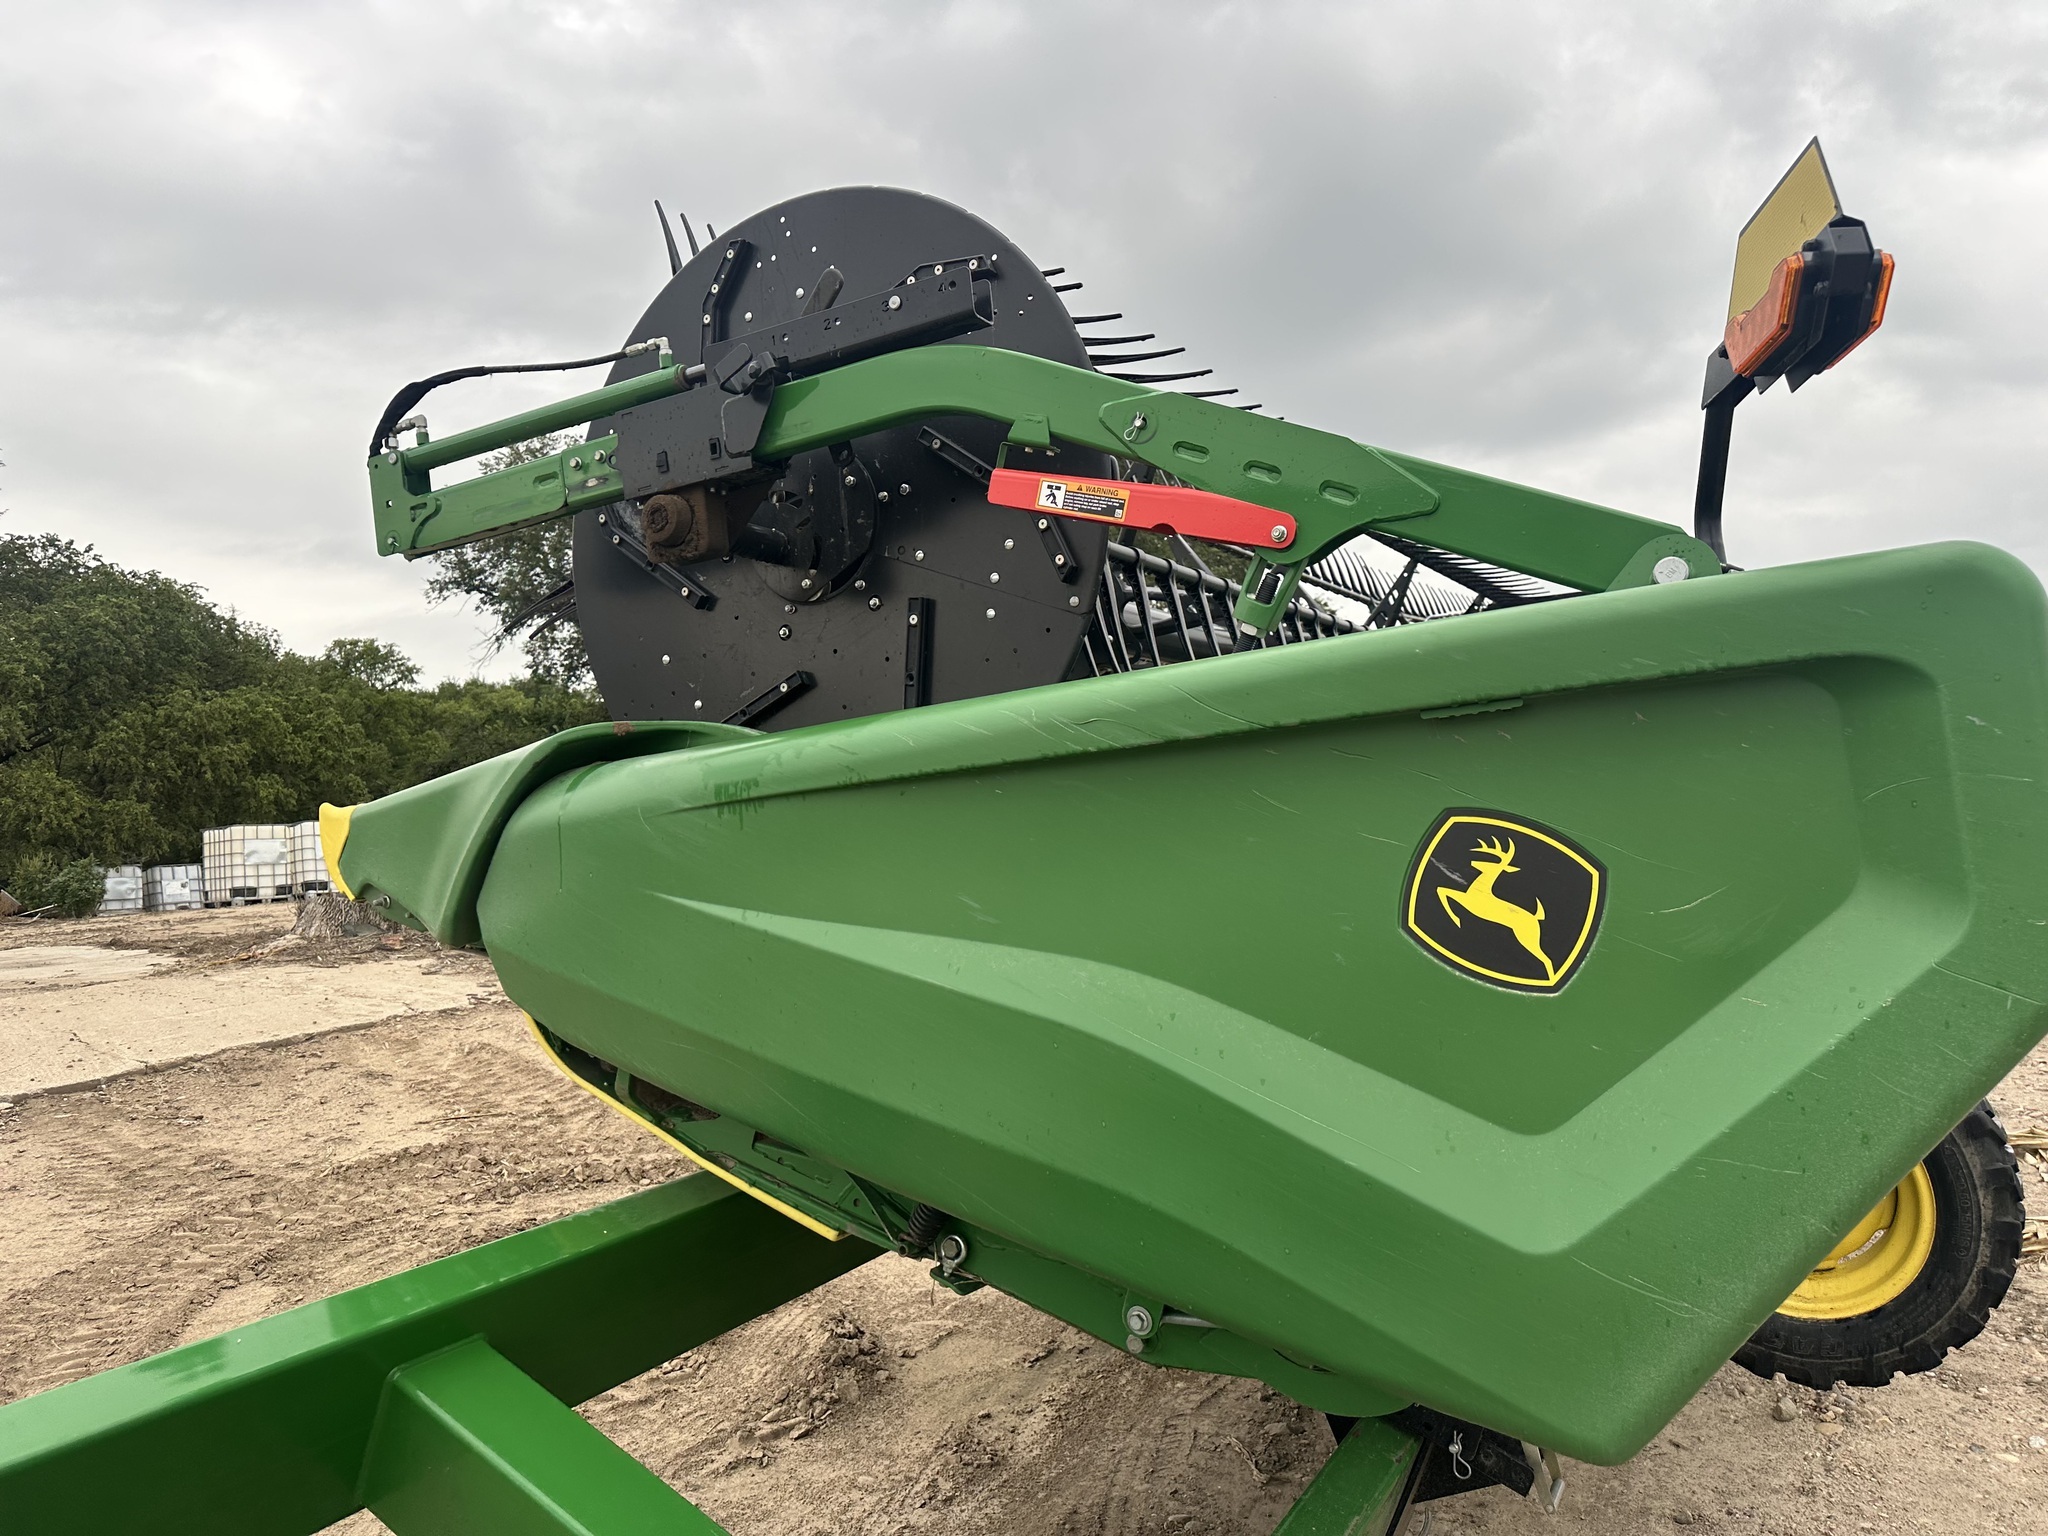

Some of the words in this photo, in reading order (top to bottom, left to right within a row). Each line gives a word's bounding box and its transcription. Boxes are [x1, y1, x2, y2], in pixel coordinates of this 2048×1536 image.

[823, 318, 832, 331] 2
[881, 300, 890, 313] 3
[938, 282, 947, 292] 4
[1085, 485, 1119, 497] WARNING
